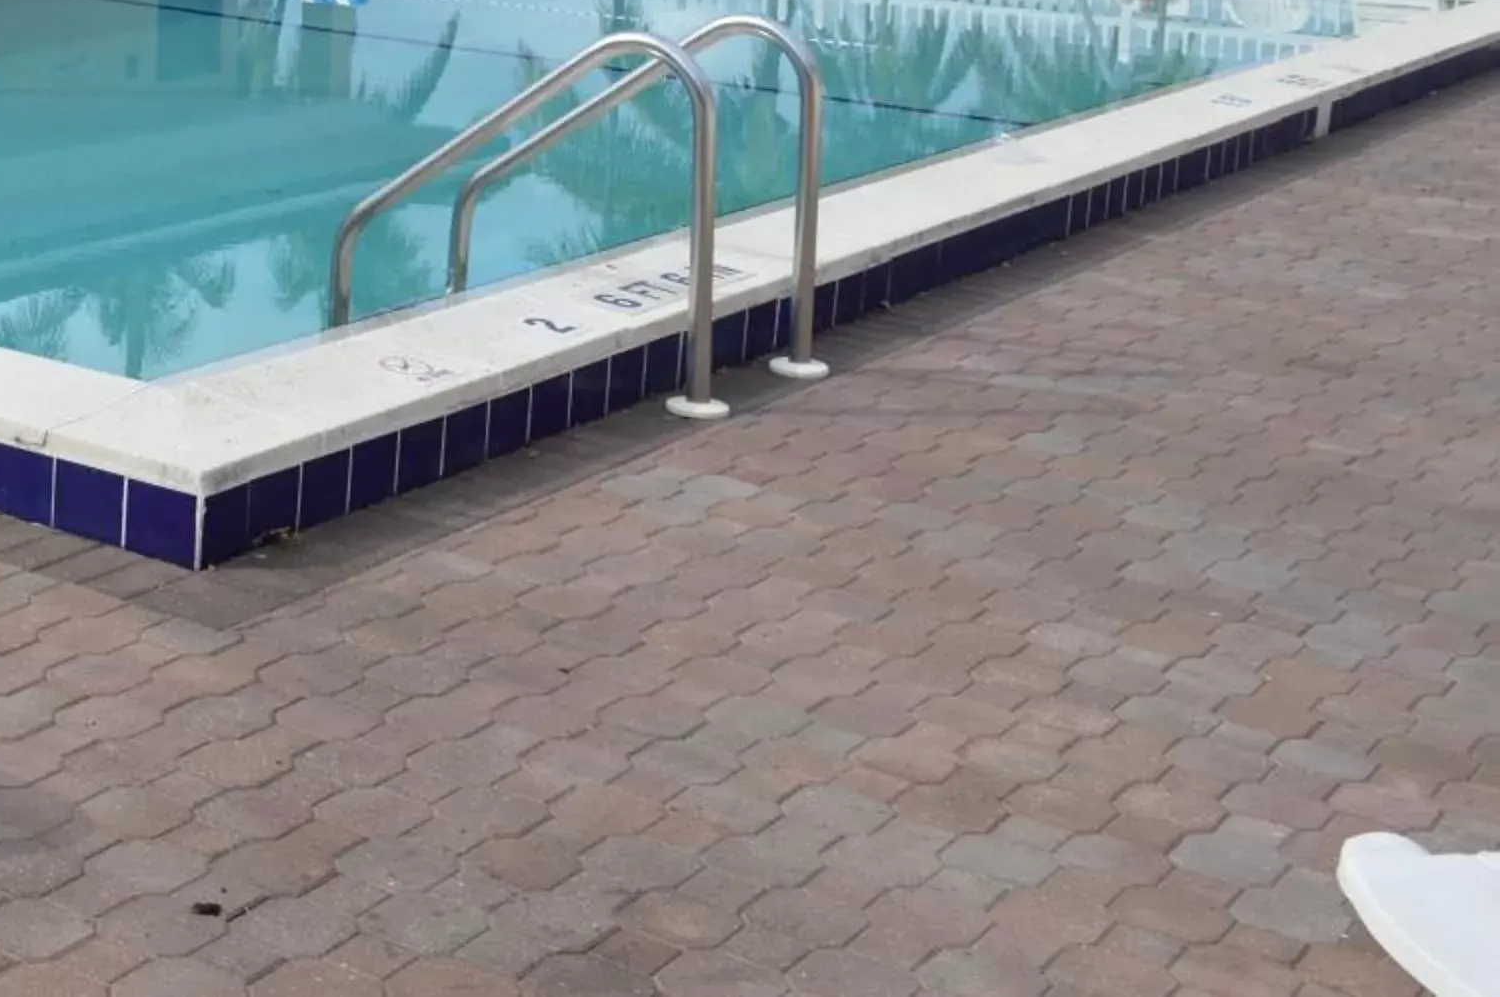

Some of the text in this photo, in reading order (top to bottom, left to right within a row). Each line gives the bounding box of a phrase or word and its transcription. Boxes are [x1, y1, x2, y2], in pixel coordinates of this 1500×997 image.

[593, 293, 642, 309] 6
[620, 280, 677, 300] FT
[523, 317, 576, 334] 2
